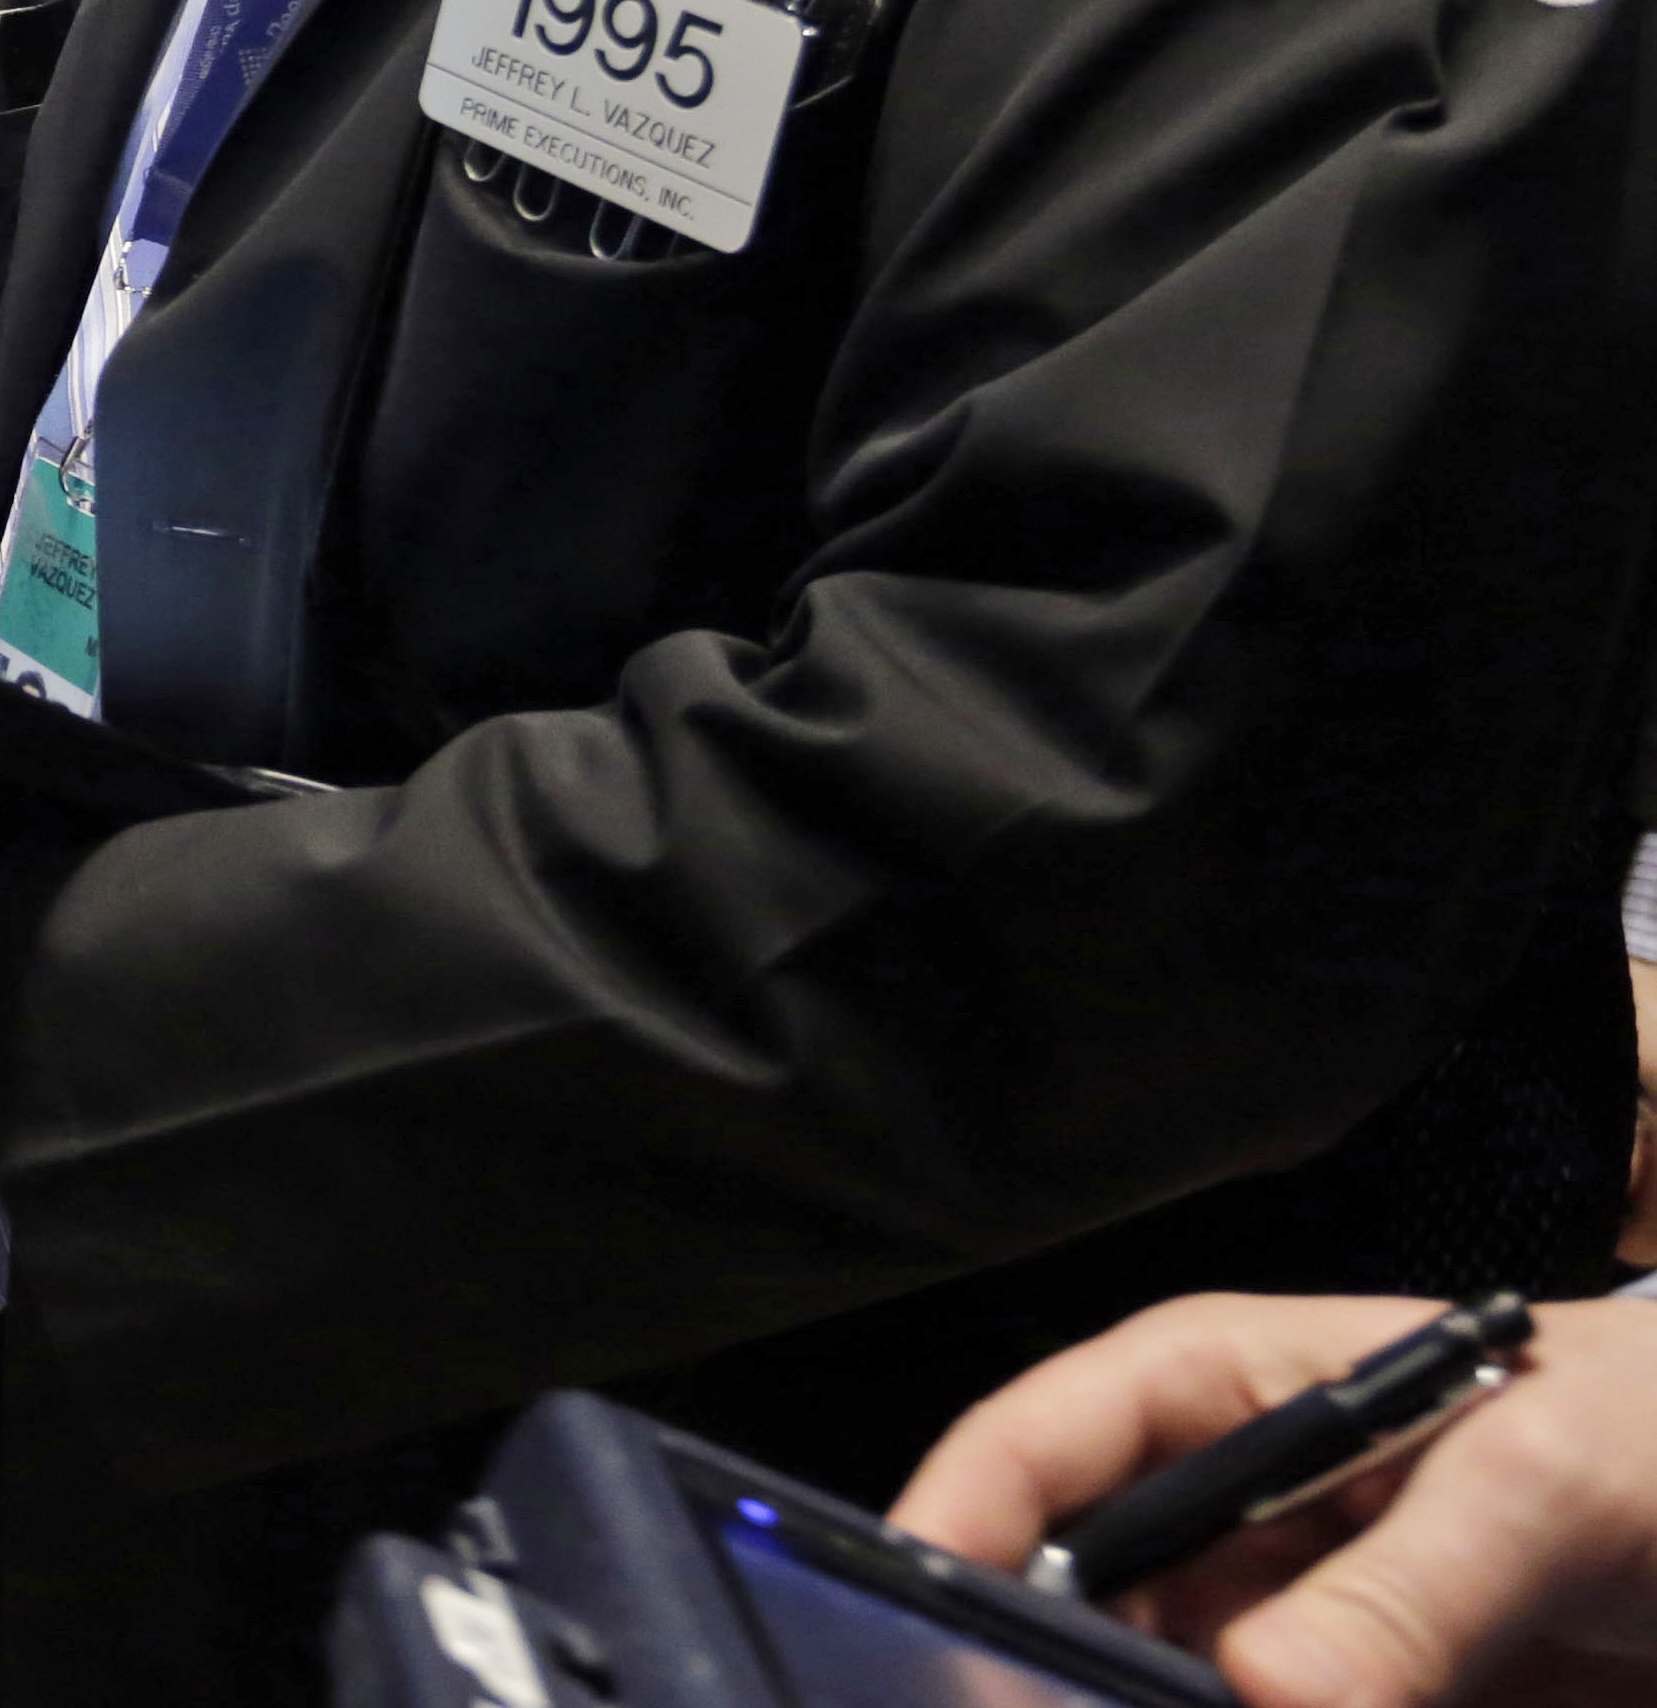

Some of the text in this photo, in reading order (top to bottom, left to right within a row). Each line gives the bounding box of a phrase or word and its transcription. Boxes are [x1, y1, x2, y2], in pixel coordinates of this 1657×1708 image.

[459, 96, 696, 222] PRIME EXECUTIONS, INC.
[471, 46, 717, 170] JEFFREY L. VAZQUEZ
